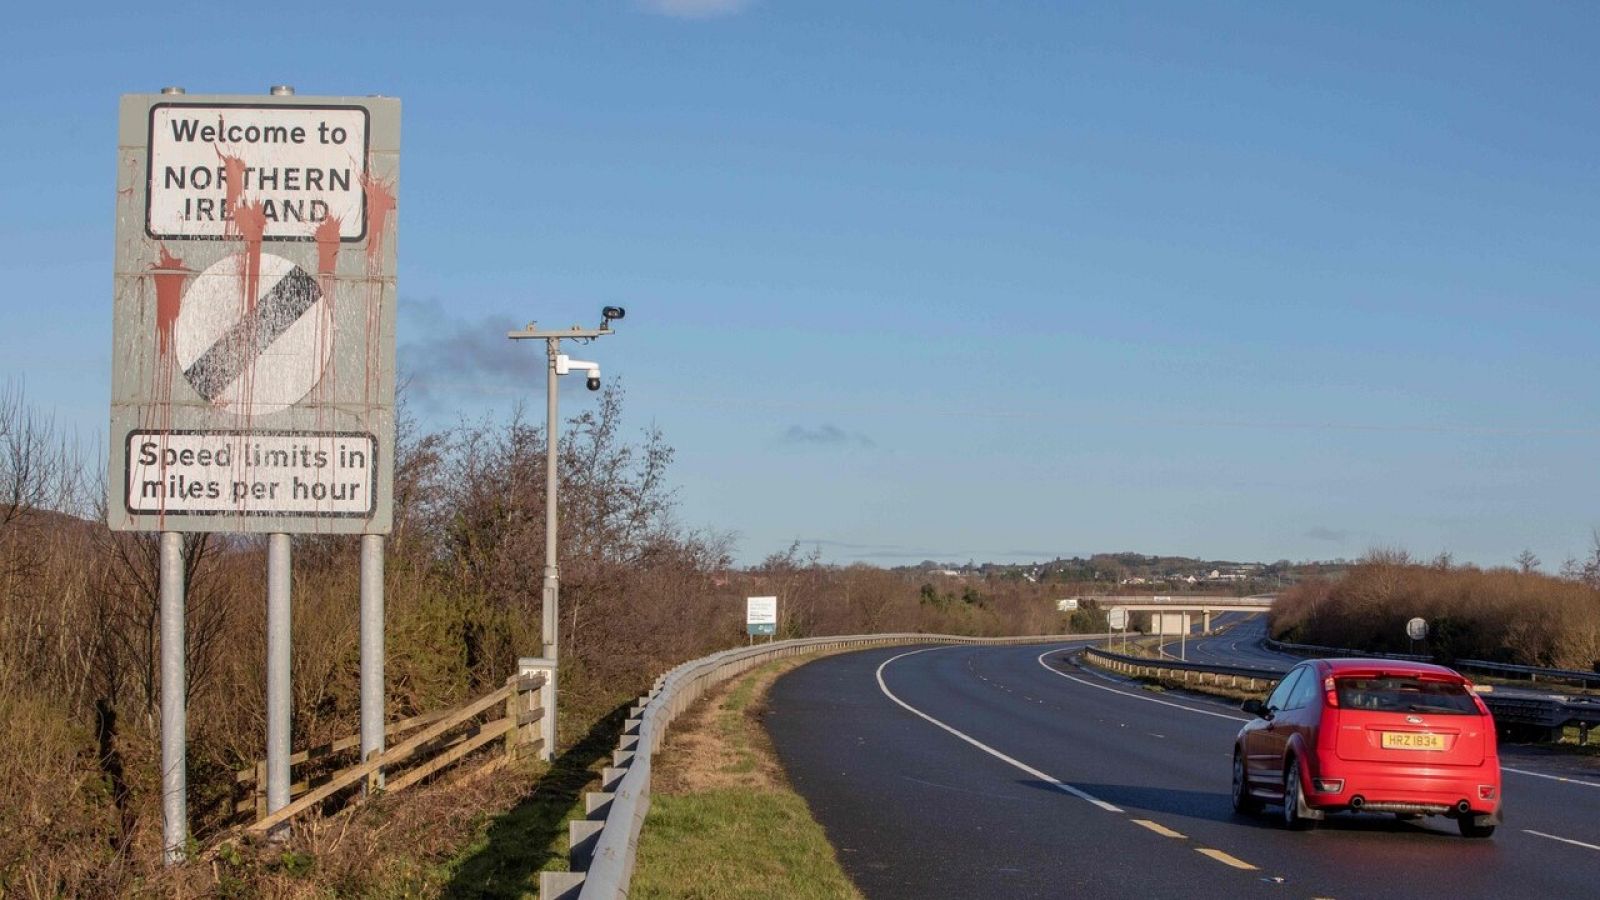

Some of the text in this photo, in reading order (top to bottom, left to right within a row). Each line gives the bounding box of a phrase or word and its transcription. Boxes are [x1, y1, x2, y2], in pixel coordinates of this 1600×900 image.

[171, 118, 347, 145] Welcome to
[184, 198, 329, 222] IREAND
[139, 442, 365, 470] Speed limits in
[142, 475, 360, 503] miles per hour
